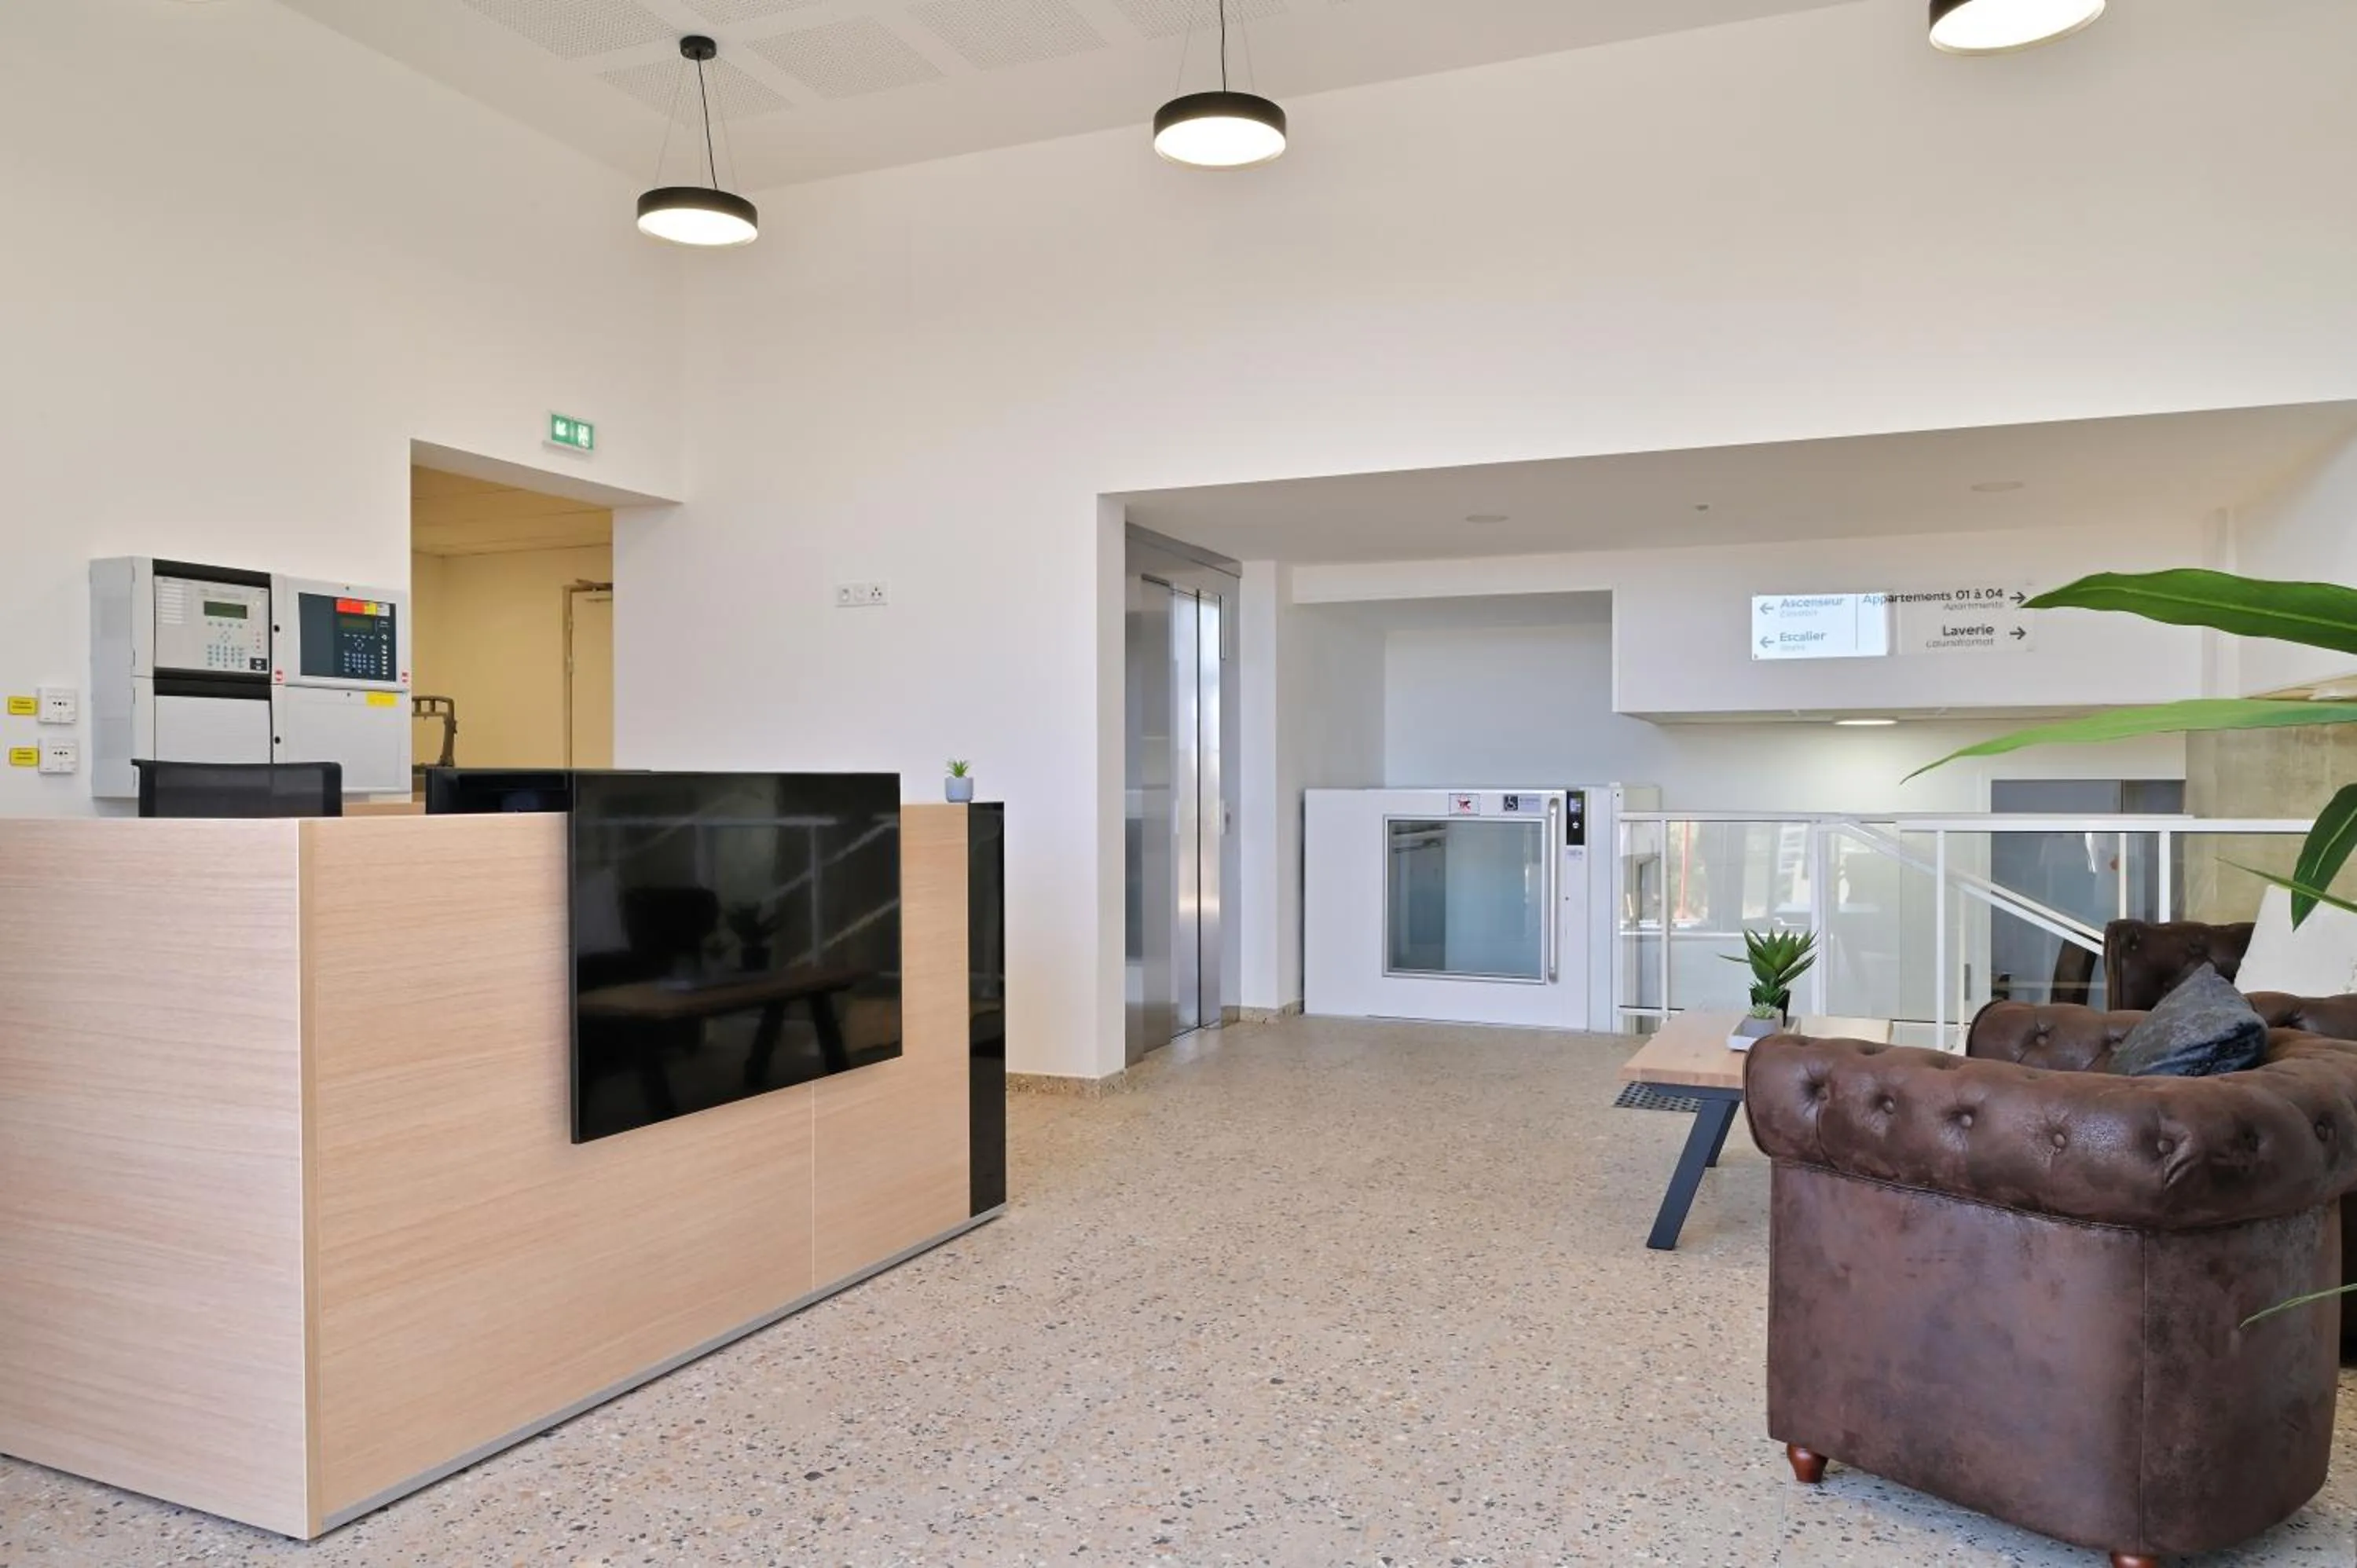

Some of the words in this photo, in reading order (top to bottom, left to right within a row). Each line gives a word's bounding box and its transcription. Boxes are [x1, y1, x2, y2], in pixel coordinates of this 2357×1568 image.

[1862, 592, 1952, 605] Appartements
[1956, 590, 1970, 601] 01
[1974, 589, 1984, 599] à
[1986, 588, 2003, 599] 04
[1780, 597, 1844, 608] Ascenseur
[1943, 624, 1994, 636] Laverie
[1780, 631, 1827, 642] Escalier
